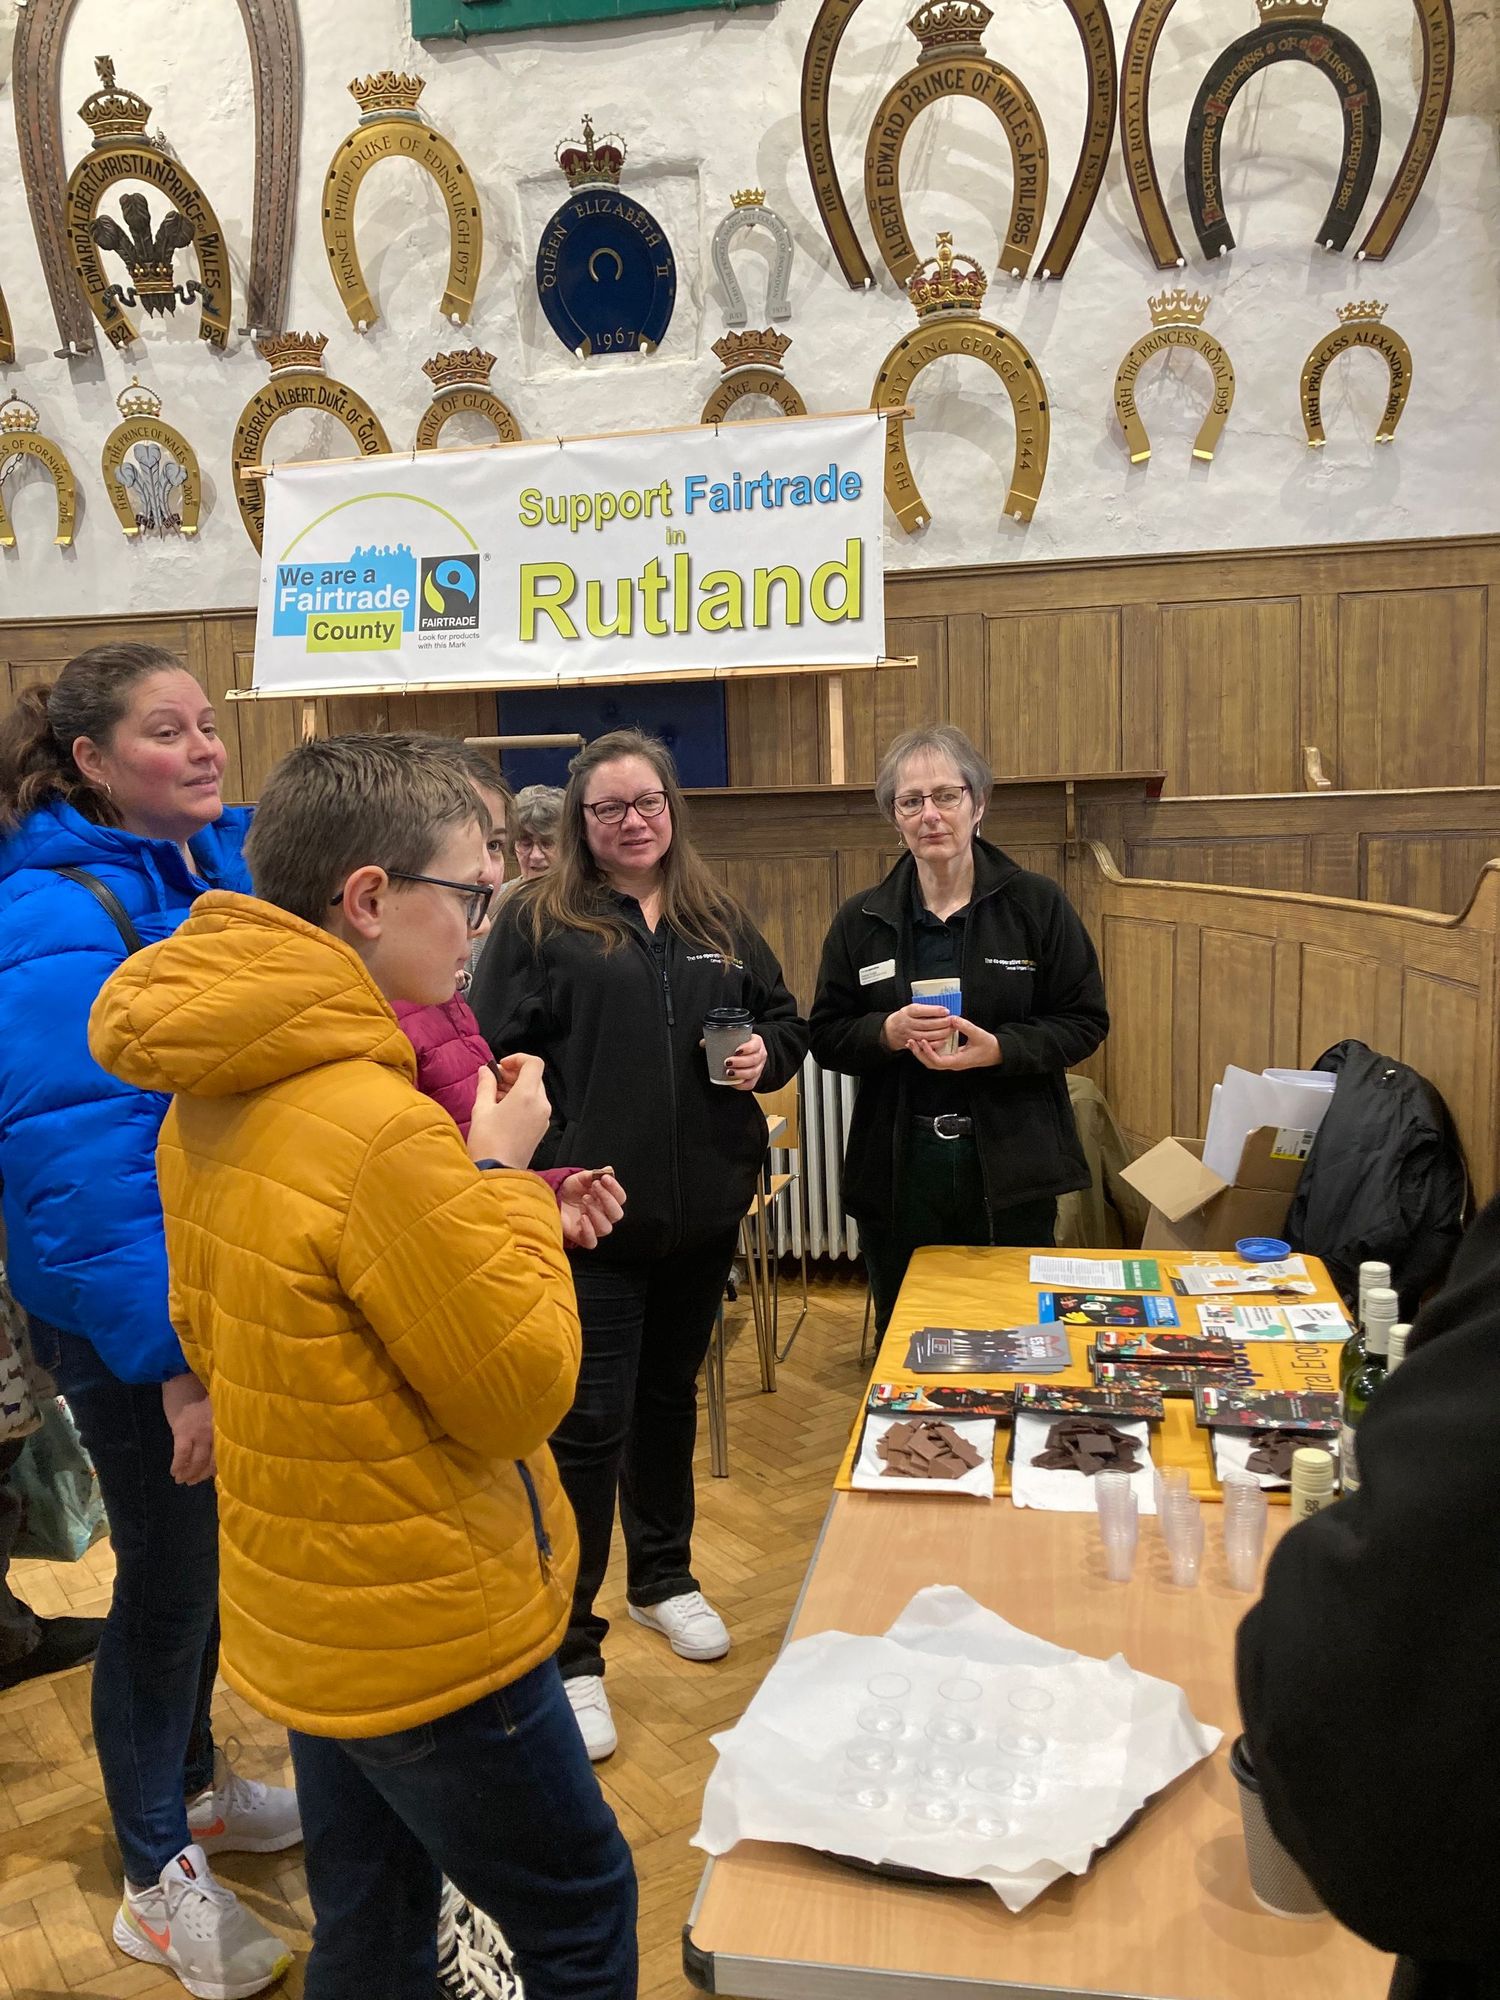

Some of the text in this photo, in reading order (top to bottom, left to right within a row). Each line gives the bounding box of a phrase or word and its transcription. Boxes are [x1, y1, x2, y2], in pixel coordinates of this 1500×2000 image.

[1084, 10, 1107, 63] KENT
[902, 68, 966, 114] PRINCE
[971, 71, 990, 95] OF
[1128, 86, 1144, 153] ROYAL
[89, 154, 165, 183] CHRISTIAN
[810, 118, 828, 176] ROYAL
[876, 112, 906, 190] EDWARD
[74, 172, 101, 233] ALBERT
[162, 167, 206, 226] PRINCE
[1017, 151, 1038, 206] APRIL
[334, 135, 471, 289] PRINCE PHILIP DUKE OF EDINBURGH 1957
[877, 197, 910, 260] ALBERT
[1011, 206, 1035, 246] 1895
[75, 234, 105, 295] EDWARD
[197, 232, 222, 290] WALES
[543, 199, 669, 288] QUEEN ELIZABETH II
[107, 326, 131, 345] 1921
[199, 325, 224, 344] 1921
[596, 326, 635, 349] 1967
[717, 381, 751, 411] DUKE
[759, 381, 780, 394] OF
[1123, 331, 1229, 418] HRH THE PRINCESS ROYAL 1999
[1308, 332, 1405, 428] HRH PRINCESS ALEXANDRA 2005
[118, 427, 150, 446] PRINCE
[151, 428, 163, 439] OF
[239, 397, 279, 461] FREDERICK
[318, 386, 348, 415] DUKE
[345, 409, 363, 425] OF
[422, 411, 443, 446] DUKE
[441, 395, 459, 413] OF
[887, 335, 1034, 490] HIS MASTY KING GEORGE VI 1944
[12, 439, 25, 449] OF
[28, 441, 66, 495] CORNWALL
[109, 444, 123, 465] THE
[164, 433, 187, 464] WALES
[115, 485, 128, 510] HRH
[518, 463, 863, 533] Support Fairtrade
[664, 525, 687, 545] in
[279, 567, 375, 587] We are a
[279, 583, 411, 613] Fairtrade
[519, 537, 864, 643] Rutland
[313, 621, 396, 644] County
[417, 641, 467, 650] with this Mark
[418, 632, 480, 643] Look for products
[421, 616, 477, 628] FAIRTRADE
